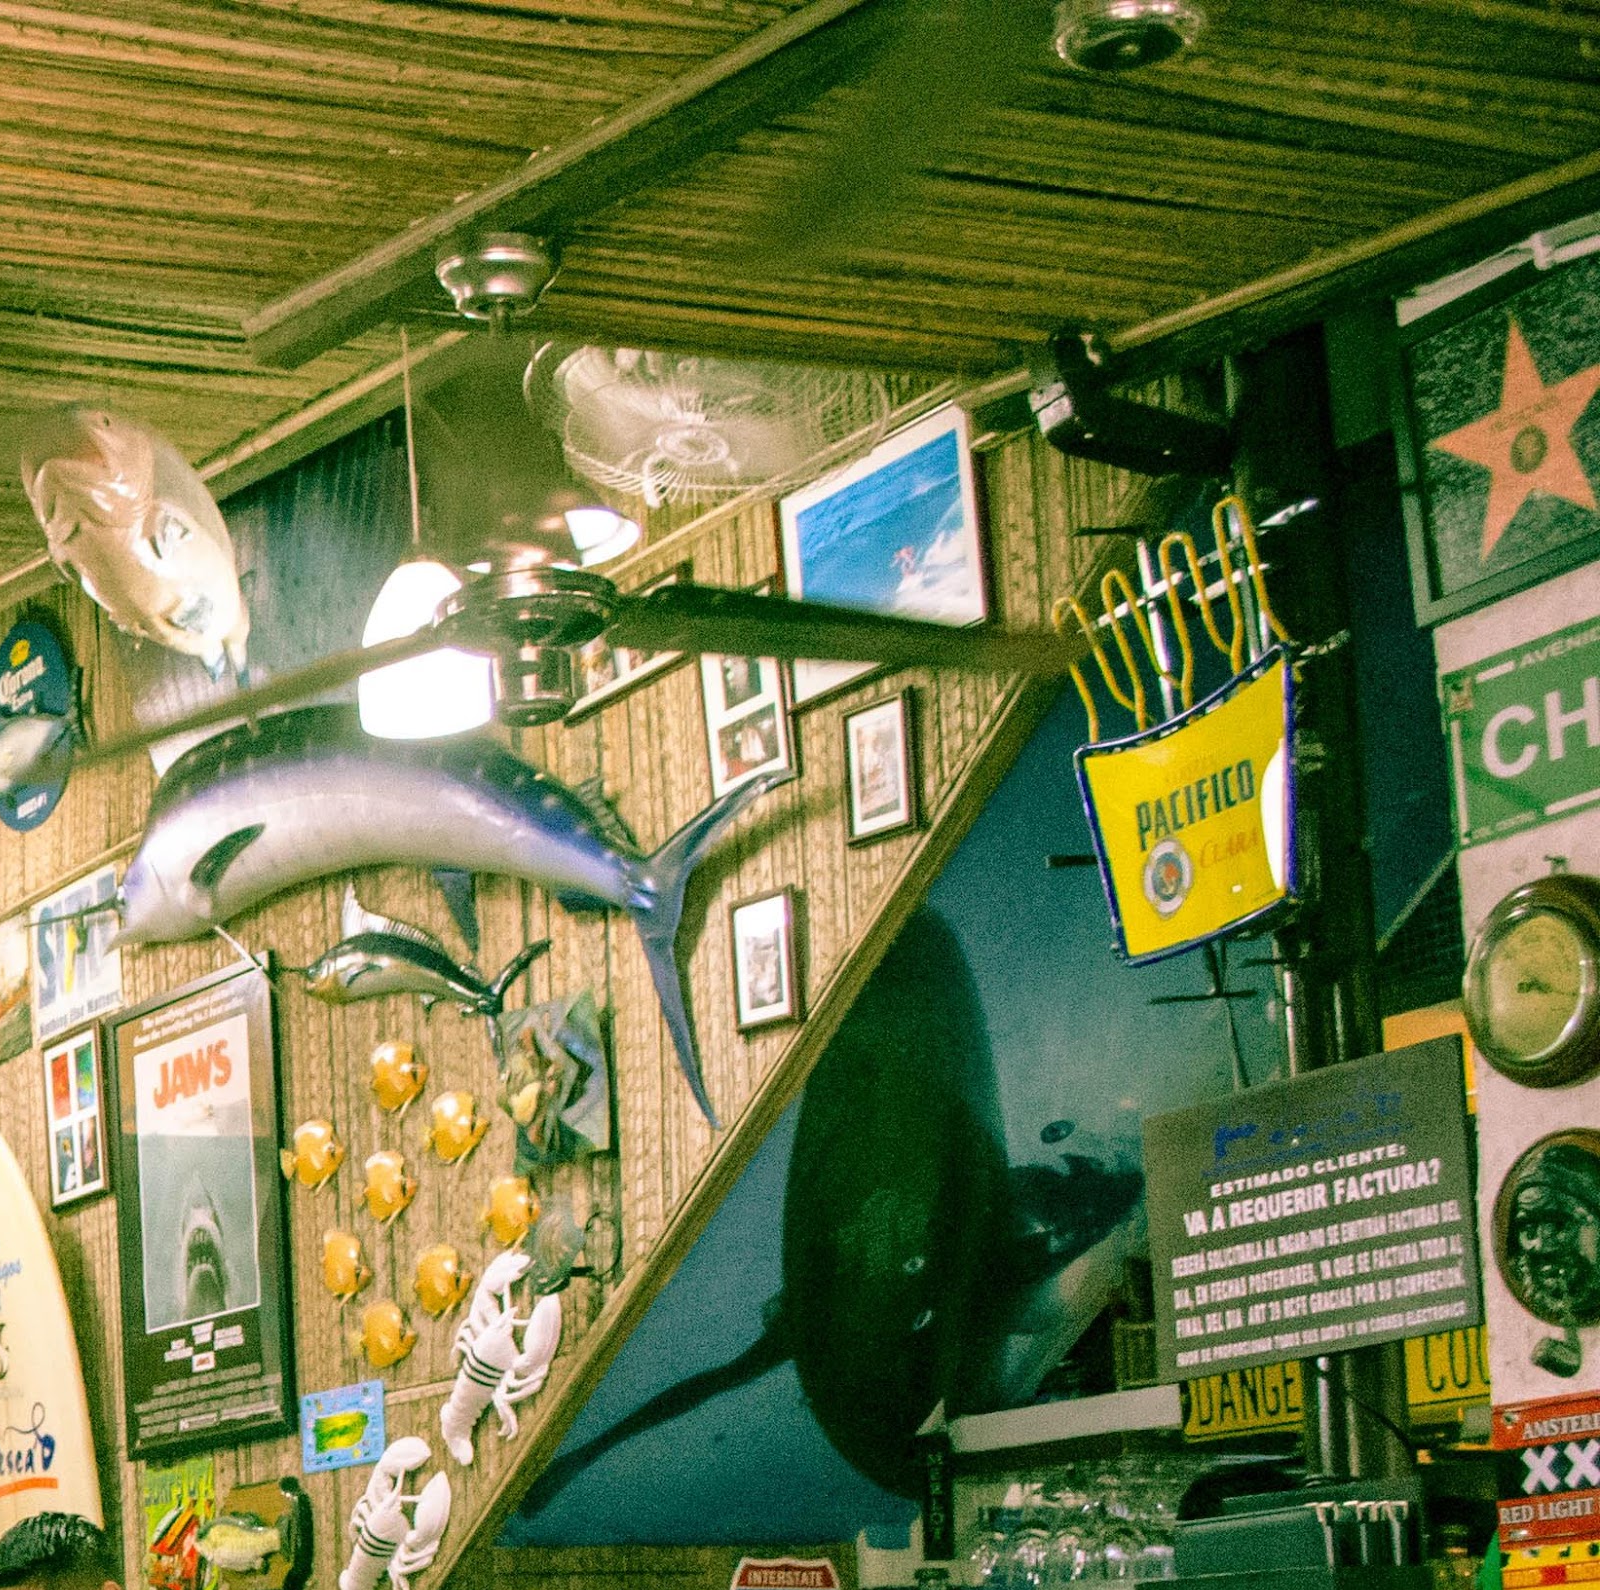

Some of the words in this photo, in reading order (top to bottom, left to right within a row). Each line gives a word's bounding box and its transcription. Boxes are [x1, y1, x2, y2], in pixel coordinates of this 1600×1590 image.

[1136, 759, 1255, 851] PACIFICO
[153, 1039, 232, 1110] JAWS
[1183, 1210, 1208, 1237] VA
[1212, 1206, 1226, 1232] A
[1229, 1183, 1328, 1228] REQUERIR
[1333, 1158, 1441, 1205] FACTURA?
[1211, 1164, 1309, 1198] ESTIMADO
[1312, 1143, 1408, 1176] CLIENTE:
[1198, 1361, 1300, 1426] DANGE
[1500, 1503, 1535, 1525] RED
[1539, 1497, 1594, 1521] LIGHT
[748, 1570, 823, 1587] INTERSTATE
